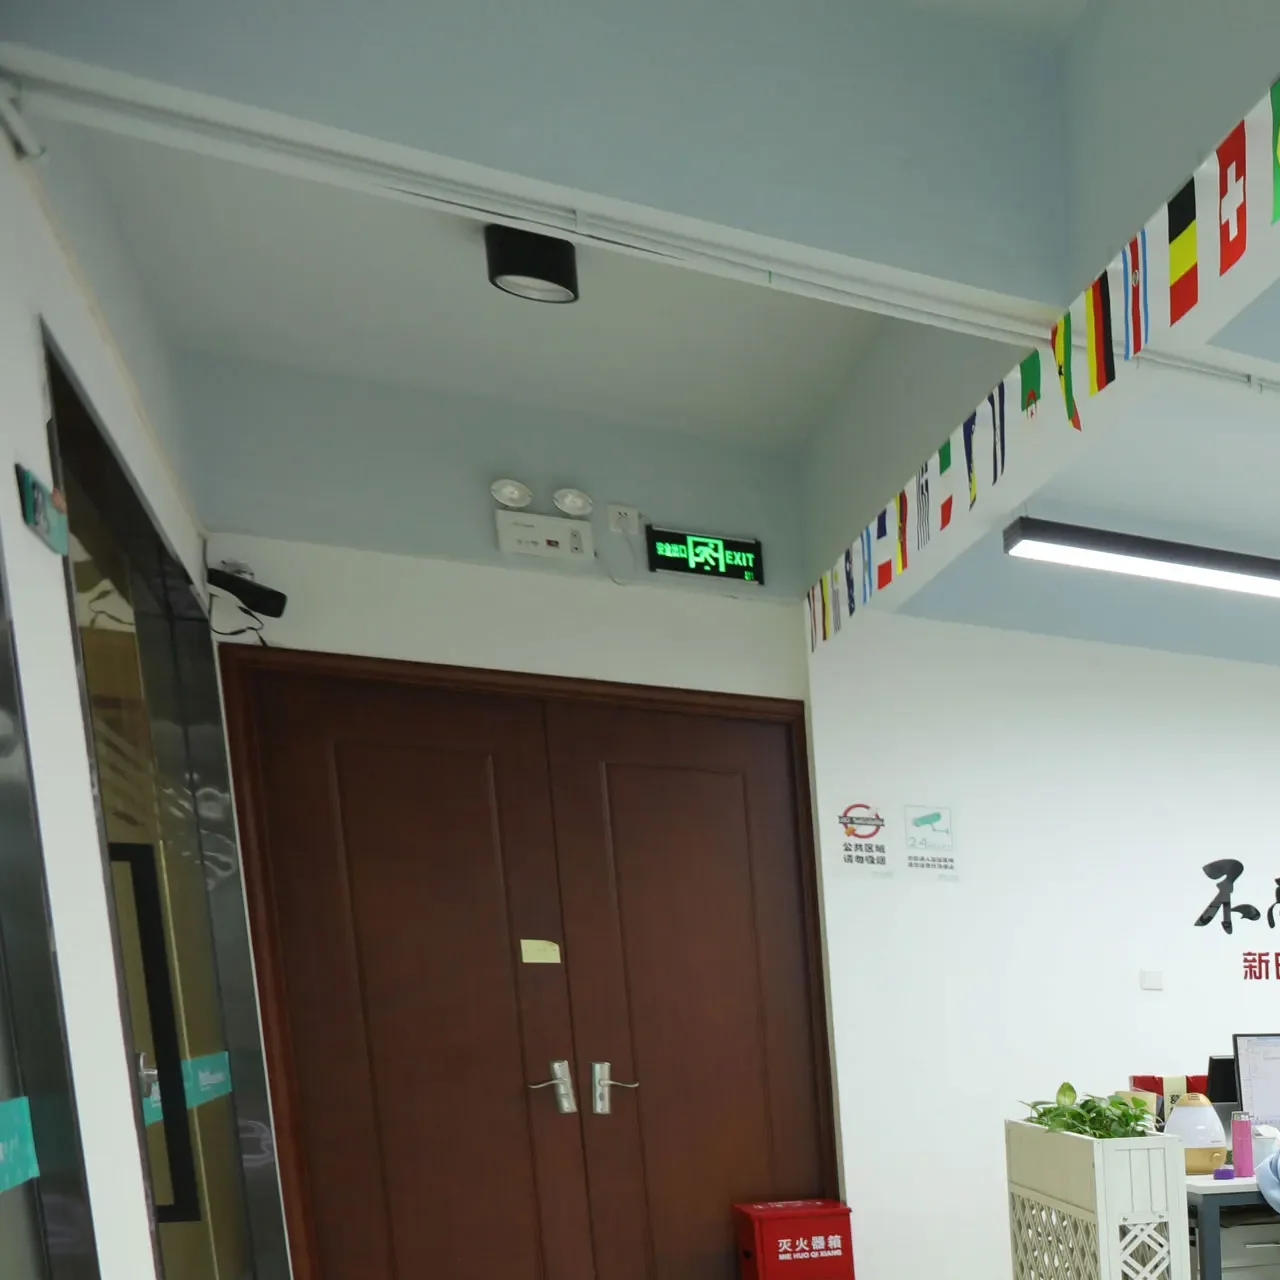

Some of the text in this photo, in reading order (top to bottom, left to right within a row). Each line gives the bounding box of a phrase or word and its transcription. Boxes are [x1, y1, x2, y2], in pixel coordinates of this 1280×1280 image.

[724, 550, 755, 568] EXIT
[843, 842, 886, 854] 公共区域
[777, 1234, 842, 1252] 灭火器箱
[792, 1251, 810, 1259] HUO
[819, 1249, 842, 1257] XIANG
